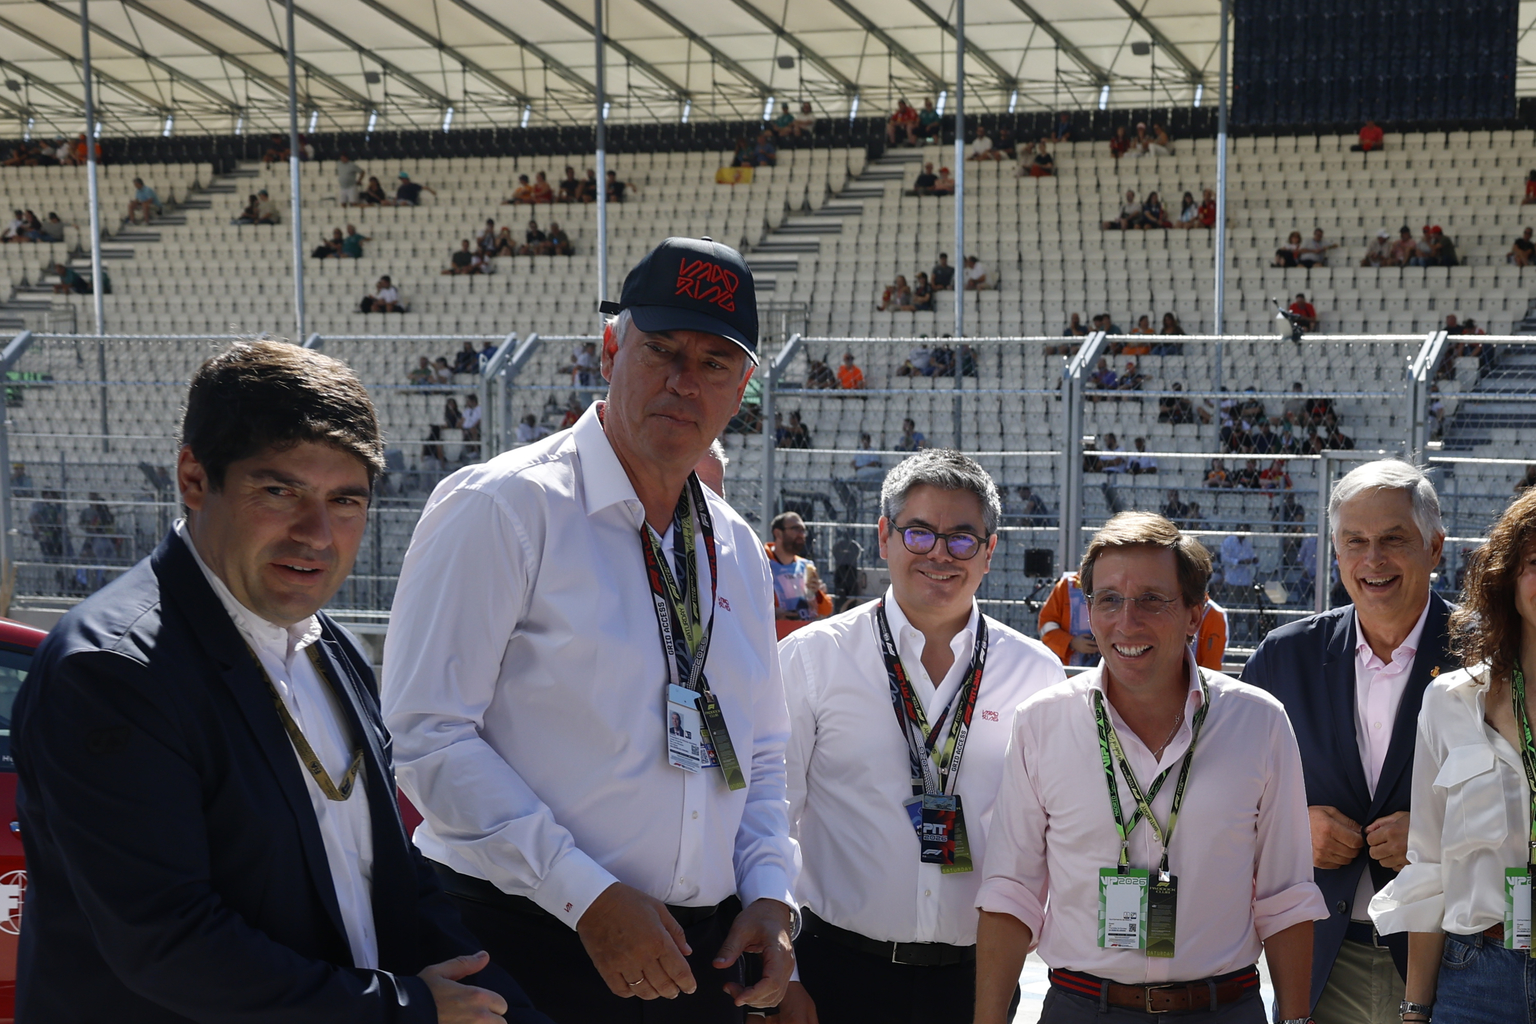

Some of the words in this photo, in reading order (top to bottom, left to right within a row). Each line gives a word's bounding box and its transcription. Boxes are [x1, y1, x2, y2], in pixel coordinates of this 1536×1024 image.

[657, 601, 672, 632] ACCESS
[680, 607, 694, 642] SATURDAY
[664, 632, 675, 656] GRID
[955, 730, 967, 754] ACCESS
[951, 753, 960, 772] GRID
[923, 822, 947, 835] PIT
